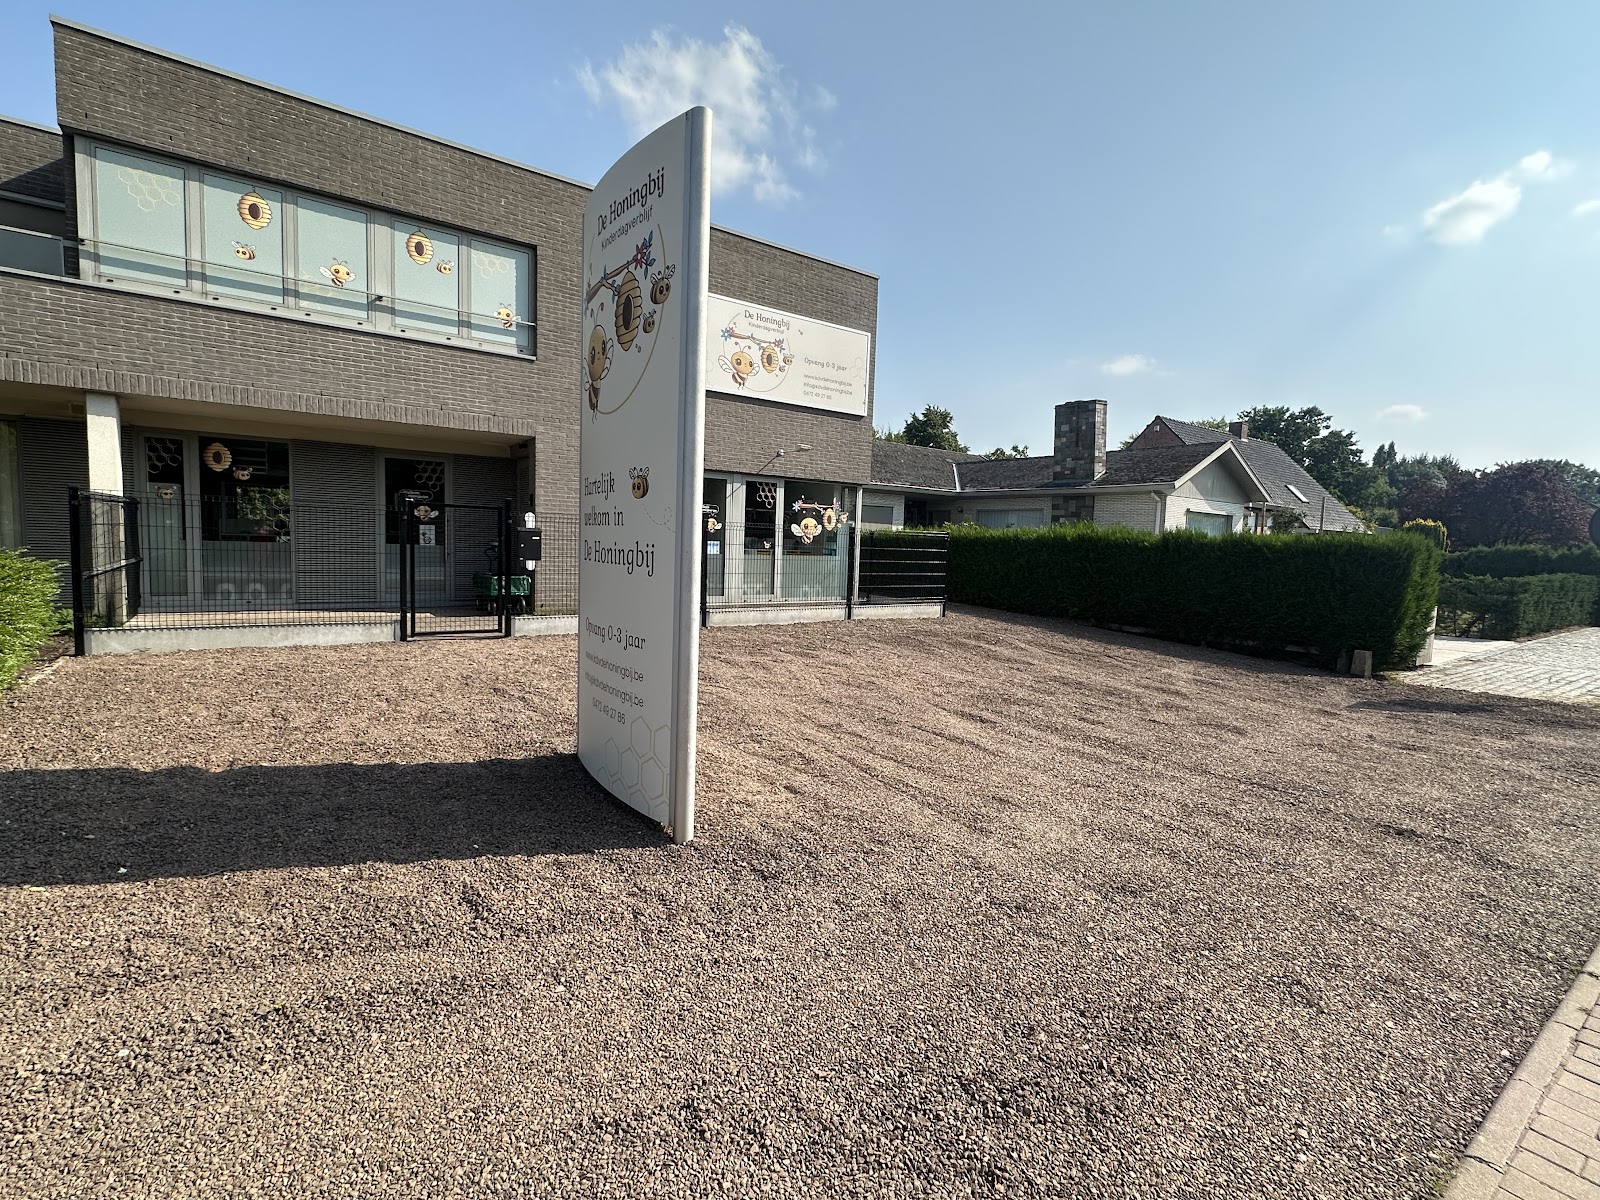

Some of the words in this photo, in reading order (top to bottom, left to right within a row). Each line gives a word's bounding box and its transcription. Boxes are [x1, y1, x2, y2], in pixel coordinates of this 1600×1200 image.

[597, 214, 608, 236] De
[609, 166, 665, 225] Honingbij
[601, 204, 653, 251] Kinderdagverblijf
[744, 309, 755, 320] De
[756, 312, 791, 330] Honingbij
[803, 356, 825, 369] Opvang
[825, 361, 836, 369] 0-3
[835, 364, 848, 372] jaar
[584, 471, 615, 501] Hartelijk
[584, 505, 610, 526] welkom
[613, 505, 625, 526] in
[584, 539, 592, 561] De
[594, 540, 655, 578] Honingbij
[586, 616, 606, 643] Opvang
[607, 625, 622, 644] 0-3
[623, 630, 646, 651] jaar
[610, 707, 617, 719] 27
